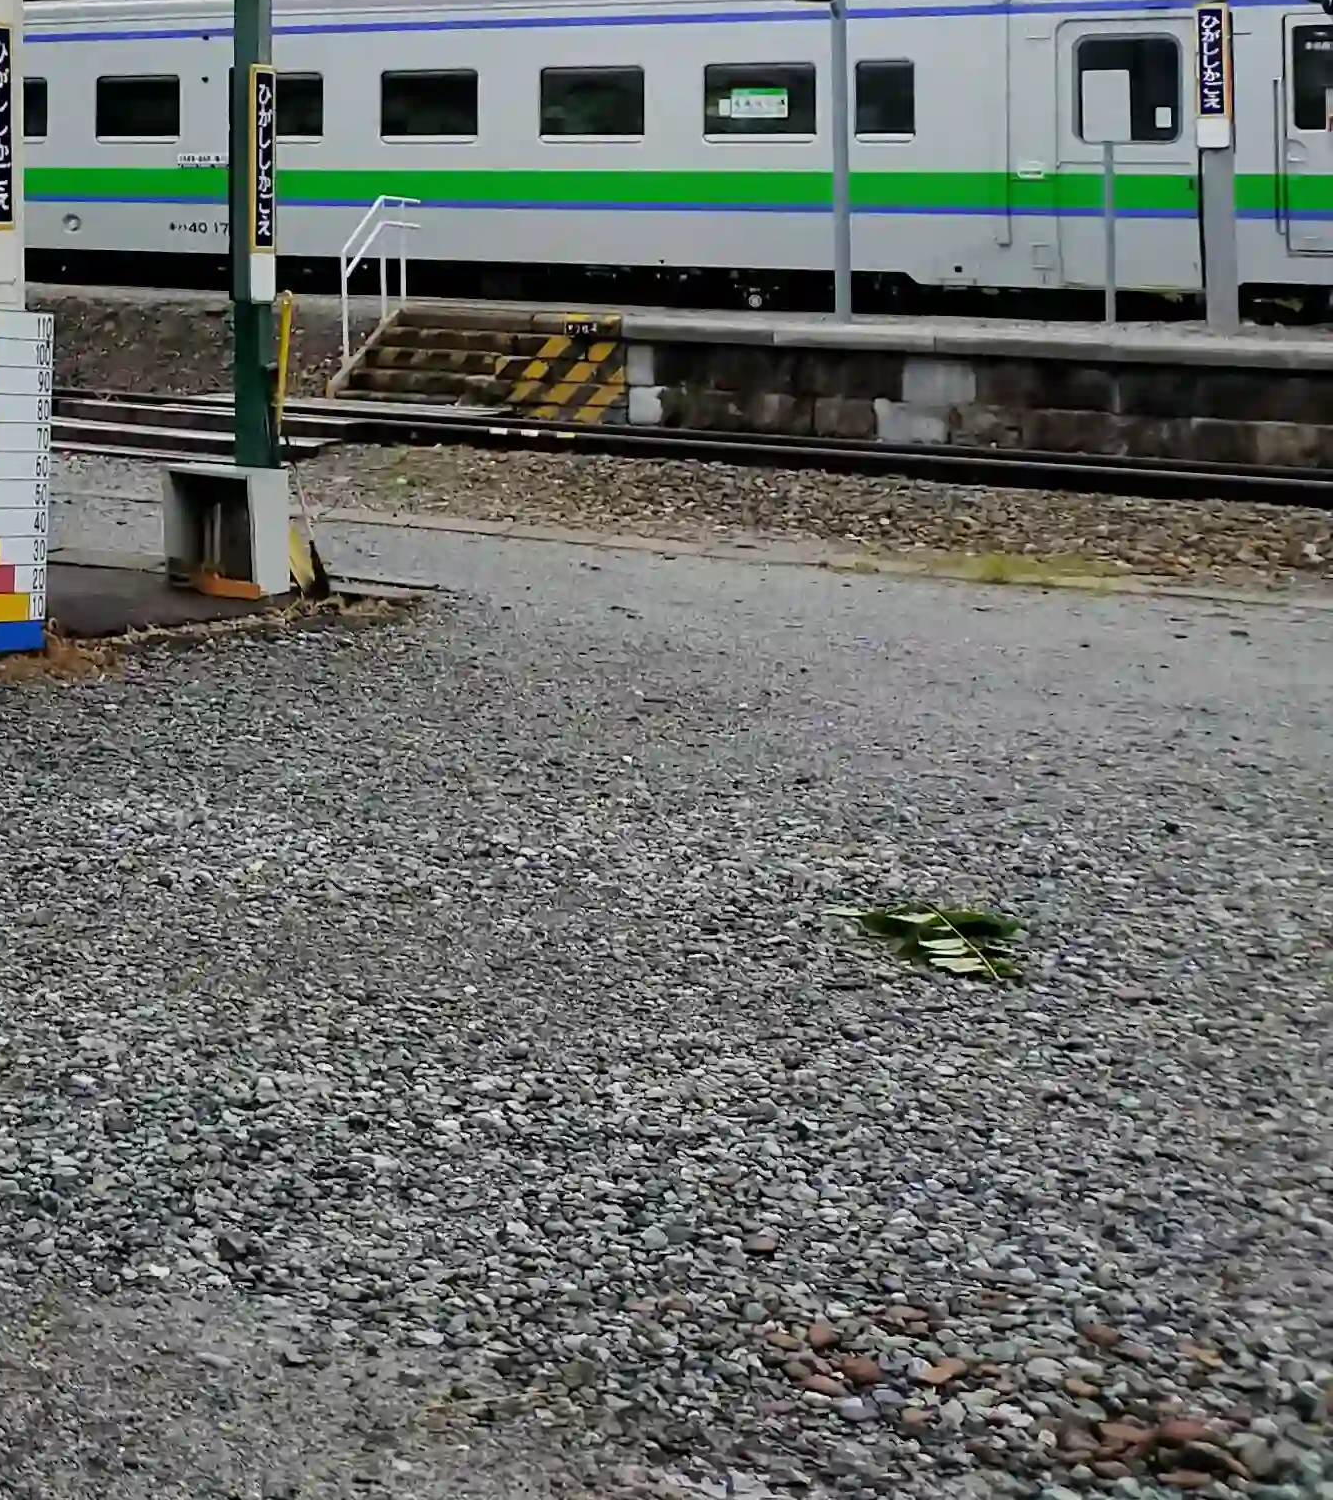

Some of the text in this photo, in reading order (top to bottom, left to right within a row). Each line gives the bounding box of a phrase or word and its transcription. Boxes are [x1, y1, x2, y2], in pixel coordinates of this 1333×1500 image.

[1200, 15, 1223, 109] ひがししかごえ
[258, 83, 273, 237] ひがししかごえ
[37, 317, 52, 339] 110
[36, 343, 50, 366] 100
[38, 371, 50, 392] 90
[37, 399, 50, 420] 80
[37, 427, 49, 449] 70
[35, 455, 48, 477] 60
[34, 483, 47, 505] 50
[33, 511, 46, 533] 40
[33, 539, 45, 561] 30
[33, 568, 45, 590] 20
[33, 595, 44, 617] 10
